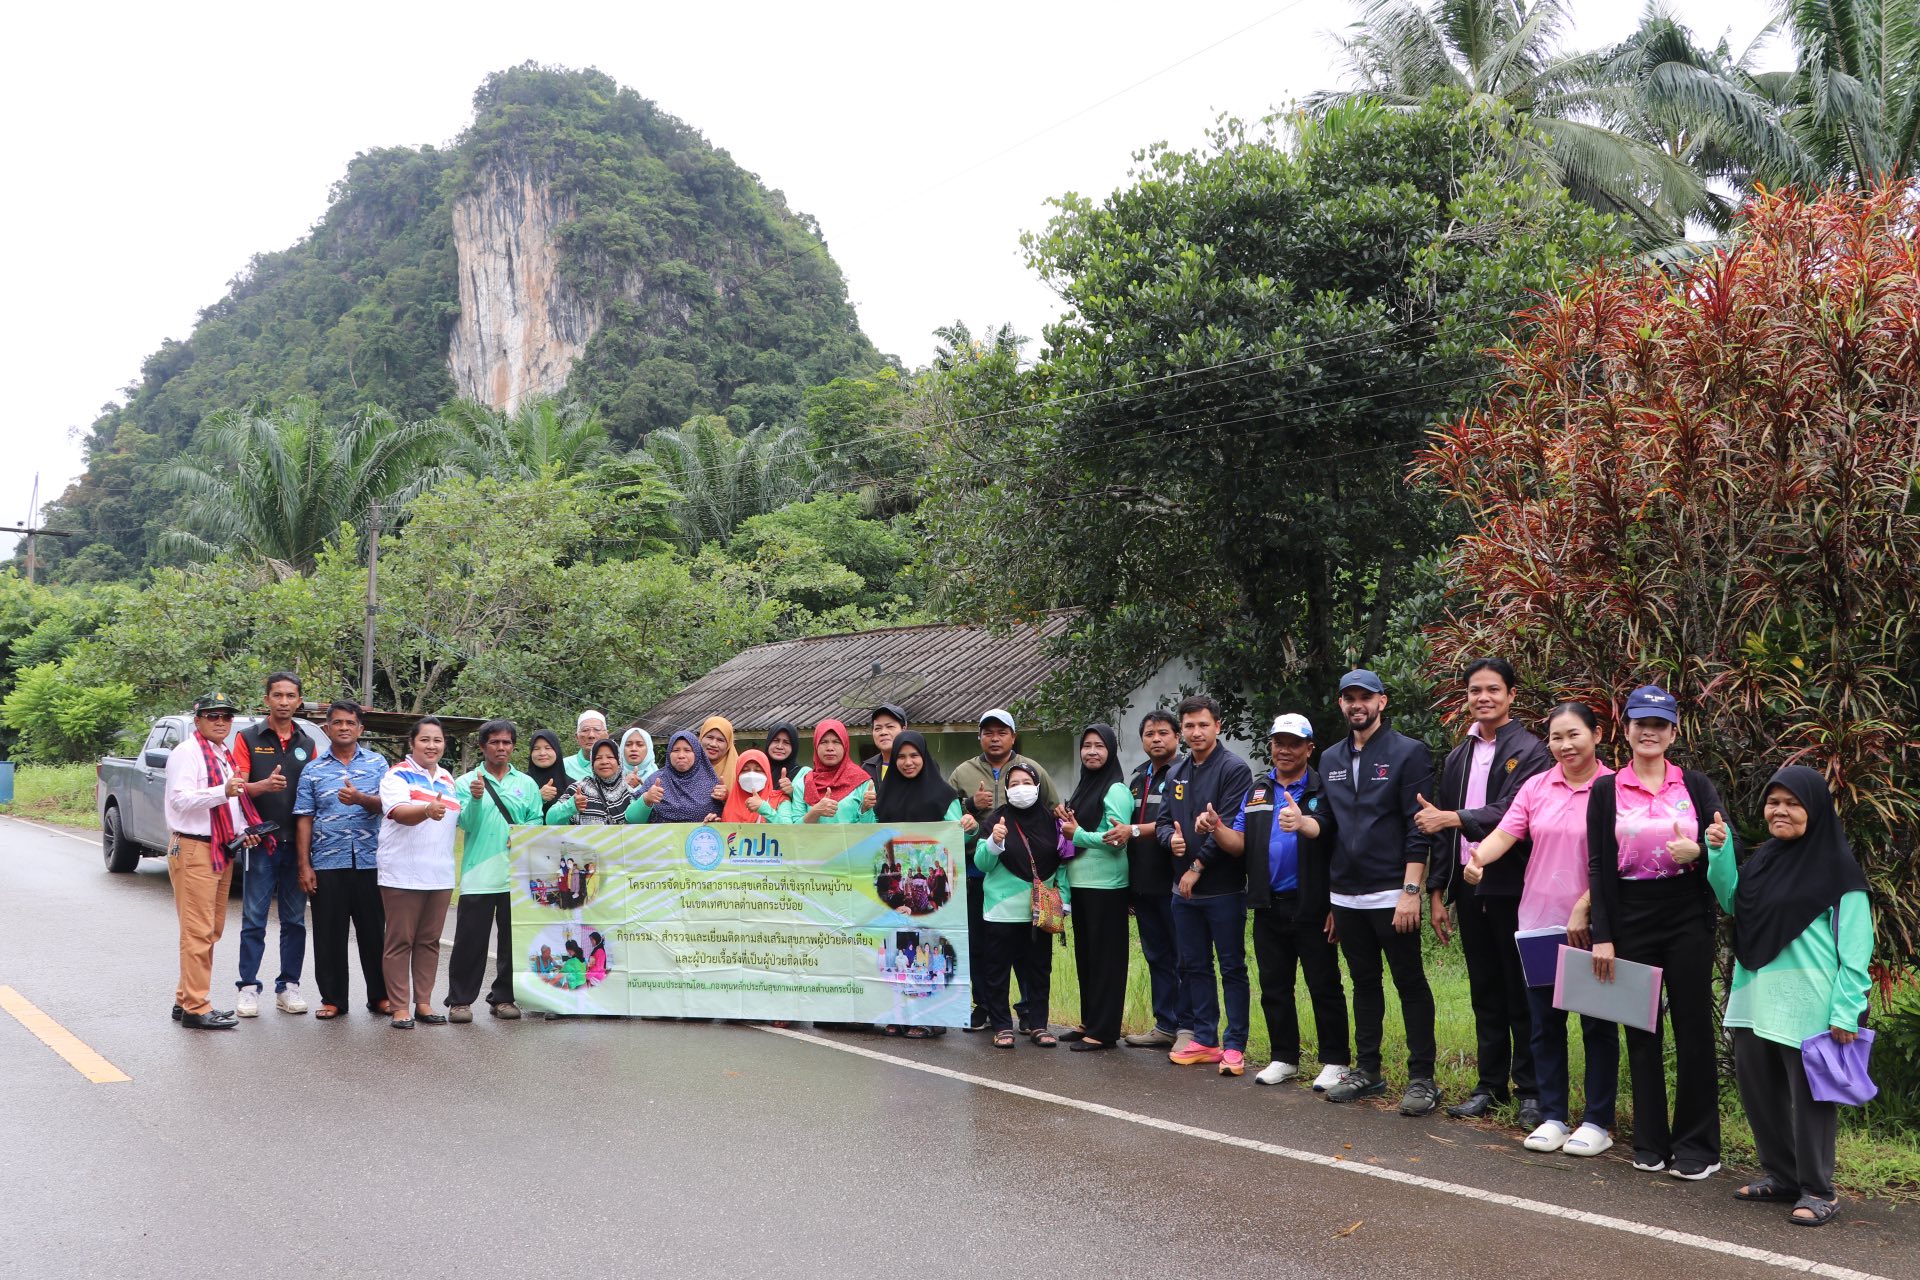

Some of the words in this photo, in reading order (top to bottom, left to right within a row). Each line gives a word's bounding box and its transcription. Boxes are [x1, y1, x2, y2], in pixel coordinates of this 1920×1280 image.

[1175, 784, 1184, 800] 9
[616, 929, 652, 942] กิจกรรม
